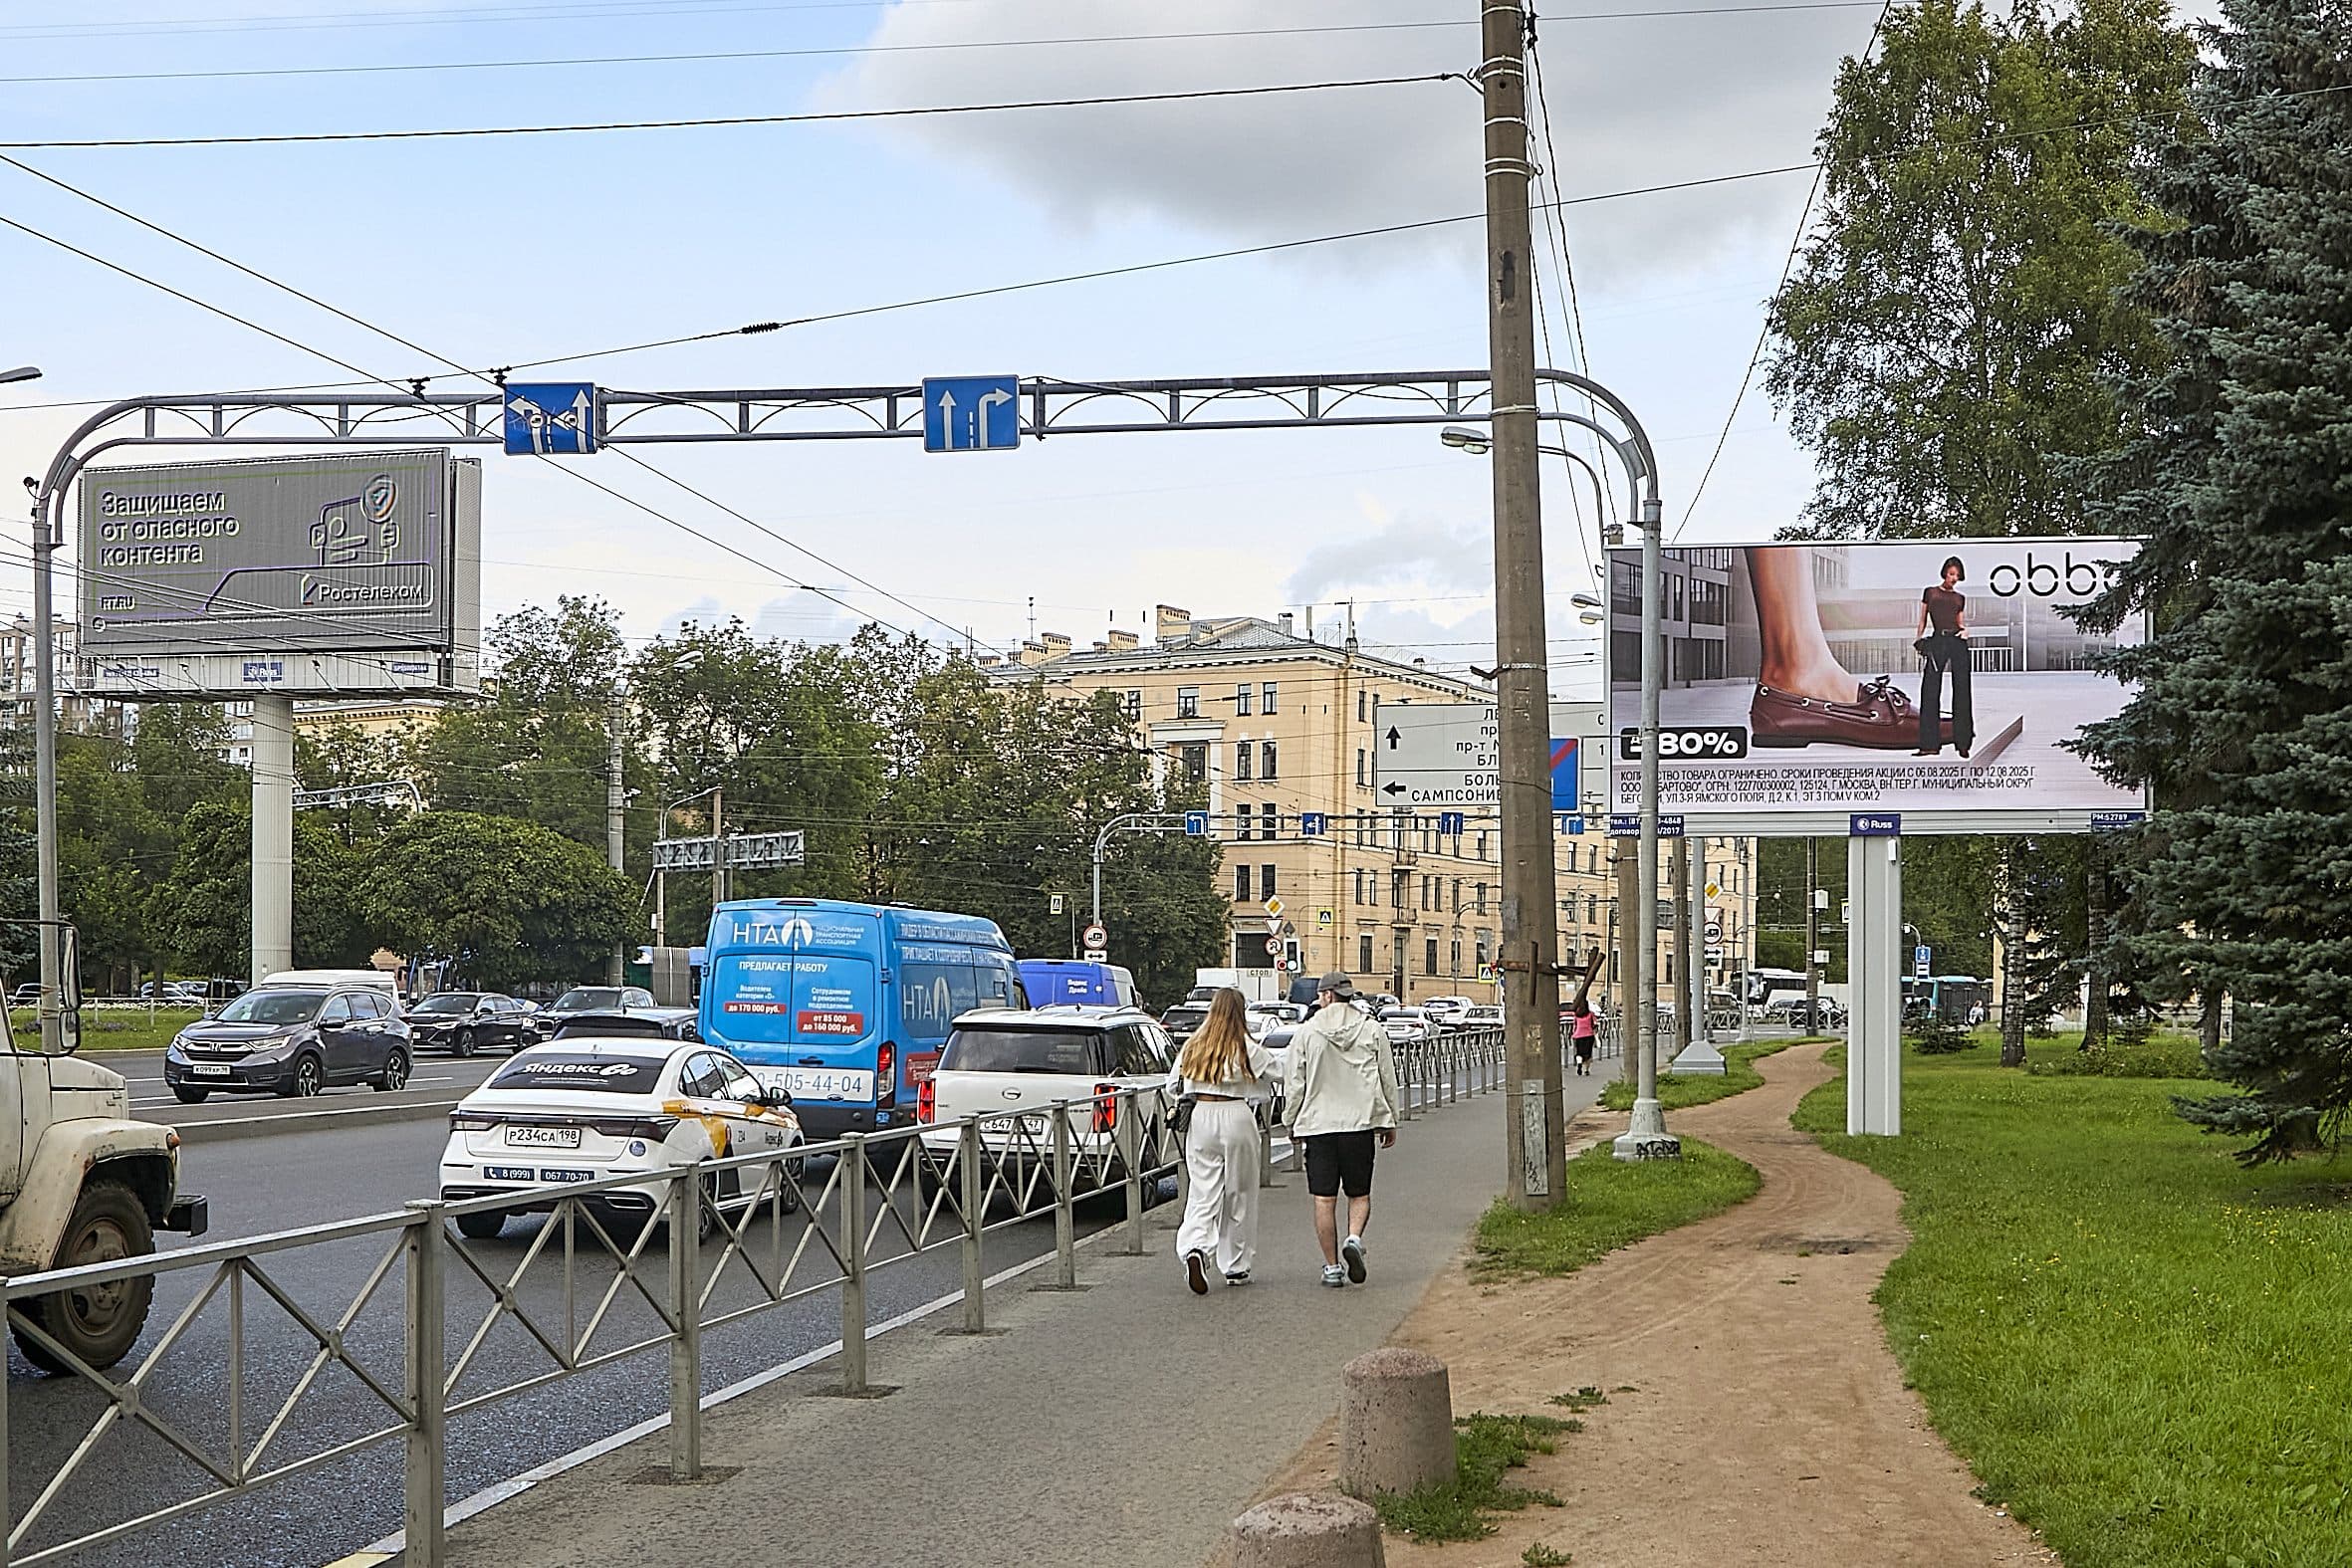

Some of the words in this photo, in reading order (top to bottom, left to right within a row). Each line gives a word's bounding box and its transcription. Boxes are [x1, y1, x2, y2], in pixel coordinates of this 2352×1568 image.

[102, 492, 225, 517] Защищаем
[101, 523, 128, 542] от
[131, 516, 240, 540] опасного
[101, 544, 203, 566] контента
[318, 582, 423, 603] Ростелеком
[101, 595, 134, 610] RT.RU
[1484, 708, 1499, 721] ЛЕ
[1456, 742, 1487, 755] пр-т
[1477, 754, 1497, 767] БЛ
[1464, 774, 1501, 786] БОЛЬ
[1682, 770, 1717, 781] ТОВАРА
[1780, 768, 1811, 780] СРОКИ
[1812, 768, 1874, 780] ПРОВЕДЕНИЯ
[1875, 767, 1906, 780] АКЦИИ
[1907, 768, 1914, 778] С
[1915, 766, 1960, 778] 06.08.2025
[1970, 766, 1984, 777] ПО
[1986, 766, 2028, 777] 12.08.2025
[1620, 782, 1641, 792] ООО
[1922, 777, 2004, 790] МУНИЦИПАЛЬНЫЙ
[2005, 777, 2034, 789] ОКРУГ
[1411, 788, 1502, 802] САМПСОНИЕ
[1695, 792, 1739, 803] ЯМСКОГО
[1870, 818, 1893, 829] Russ
[732, 922, 780, 945] НТА
[739, 961, 793, 972] ПРЕДЛАГАЕТ
[795, 963, 828, 973] РАБОТУ
[902, 984, 934, 1020] НТА
[765, 1006, 781, 1014] руб.
[814, 1022, 826, 1031] 160
[841, 1024, 857, 1033] руб.
[523, 1062, 601, 1074] Яндекс
[759, 1072, 862, 1092] 0-505-44-04
[984, 1118, 1013, 1129] С647
[509, 1128, 556, 1142] Р234СА
[559, 1130, 578, 1140] 198
[502, 1169, 509, 1178] 8
[510, 1169, 531, 1180] (999)
[545, 1171, 561, 1181] 067
[566, 1172, 589, 1182] 70-70
